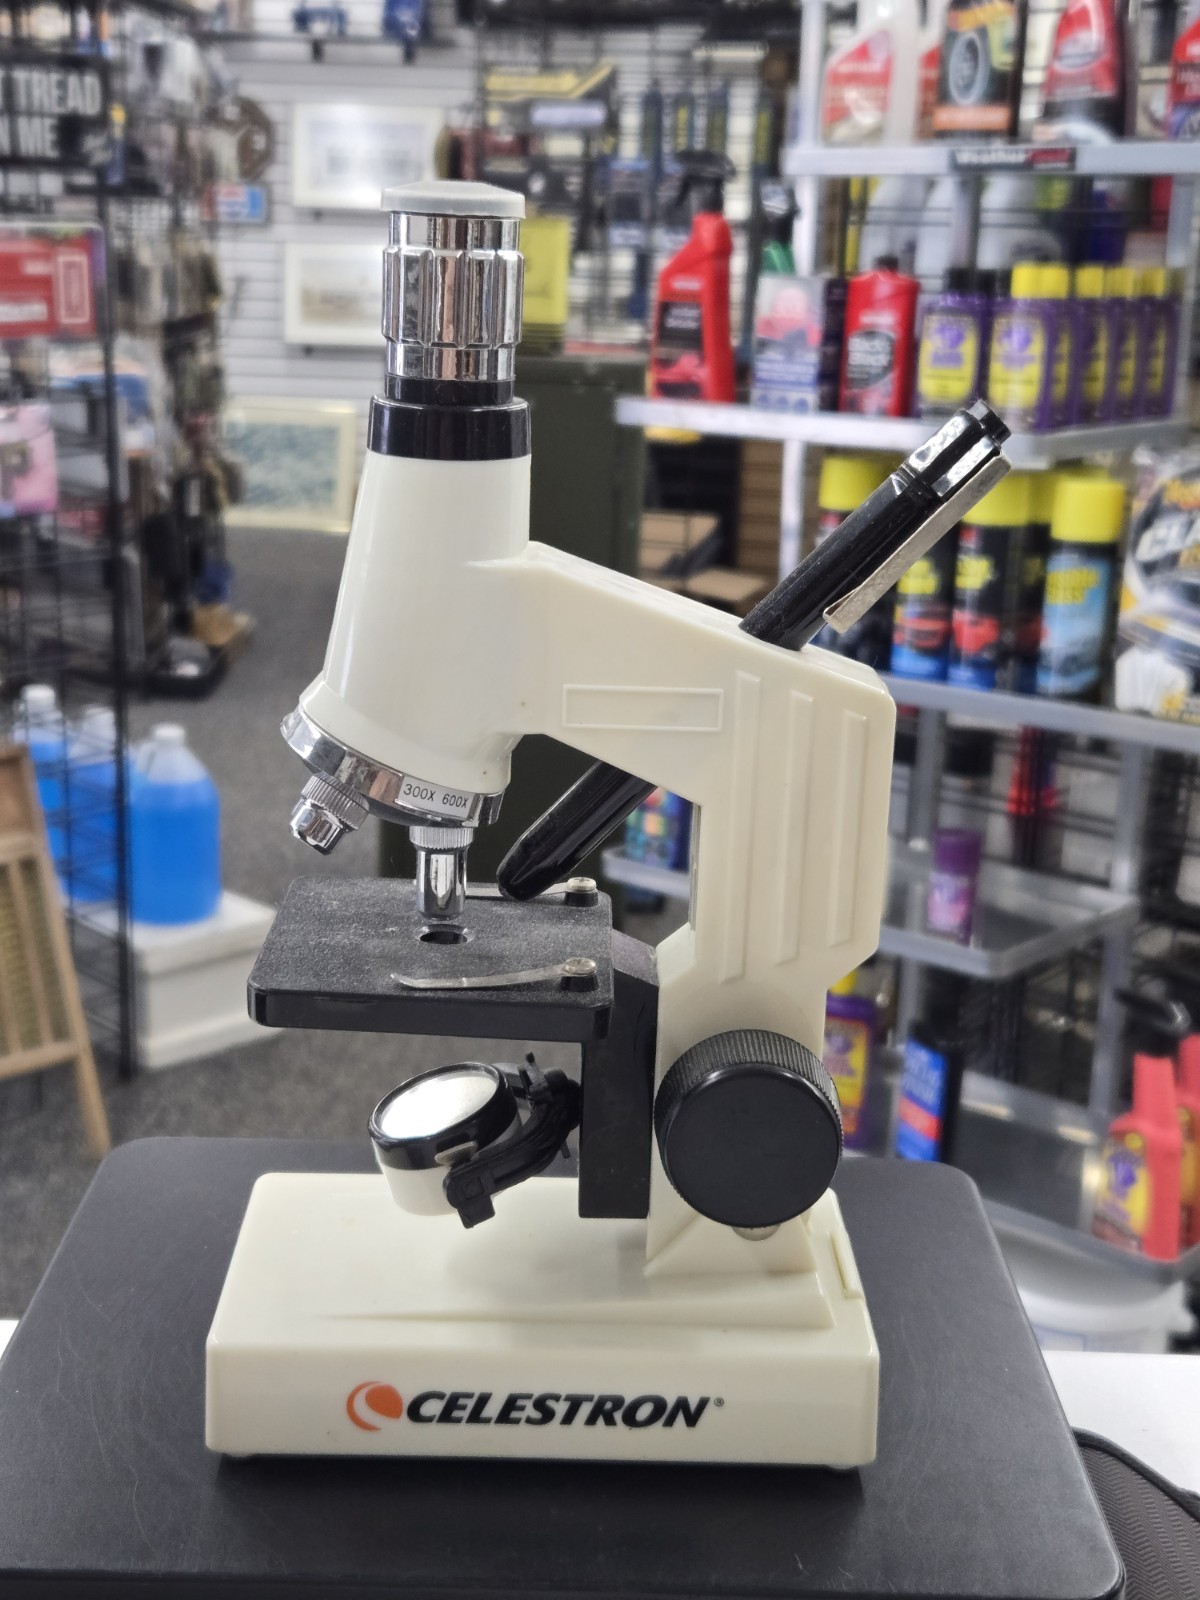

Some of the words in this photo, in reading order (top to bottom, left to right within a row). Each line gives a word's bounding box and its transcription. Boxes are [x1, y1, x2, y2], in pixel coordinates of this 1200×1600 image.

[12, 70, 101, 115] TREAD
[19, 115, 59, 158] ME
[403, 783, 436, 801] 300X
[442, 793, 469, 808] 600X
[406, 1391, 711, 1428] CELESTRON
